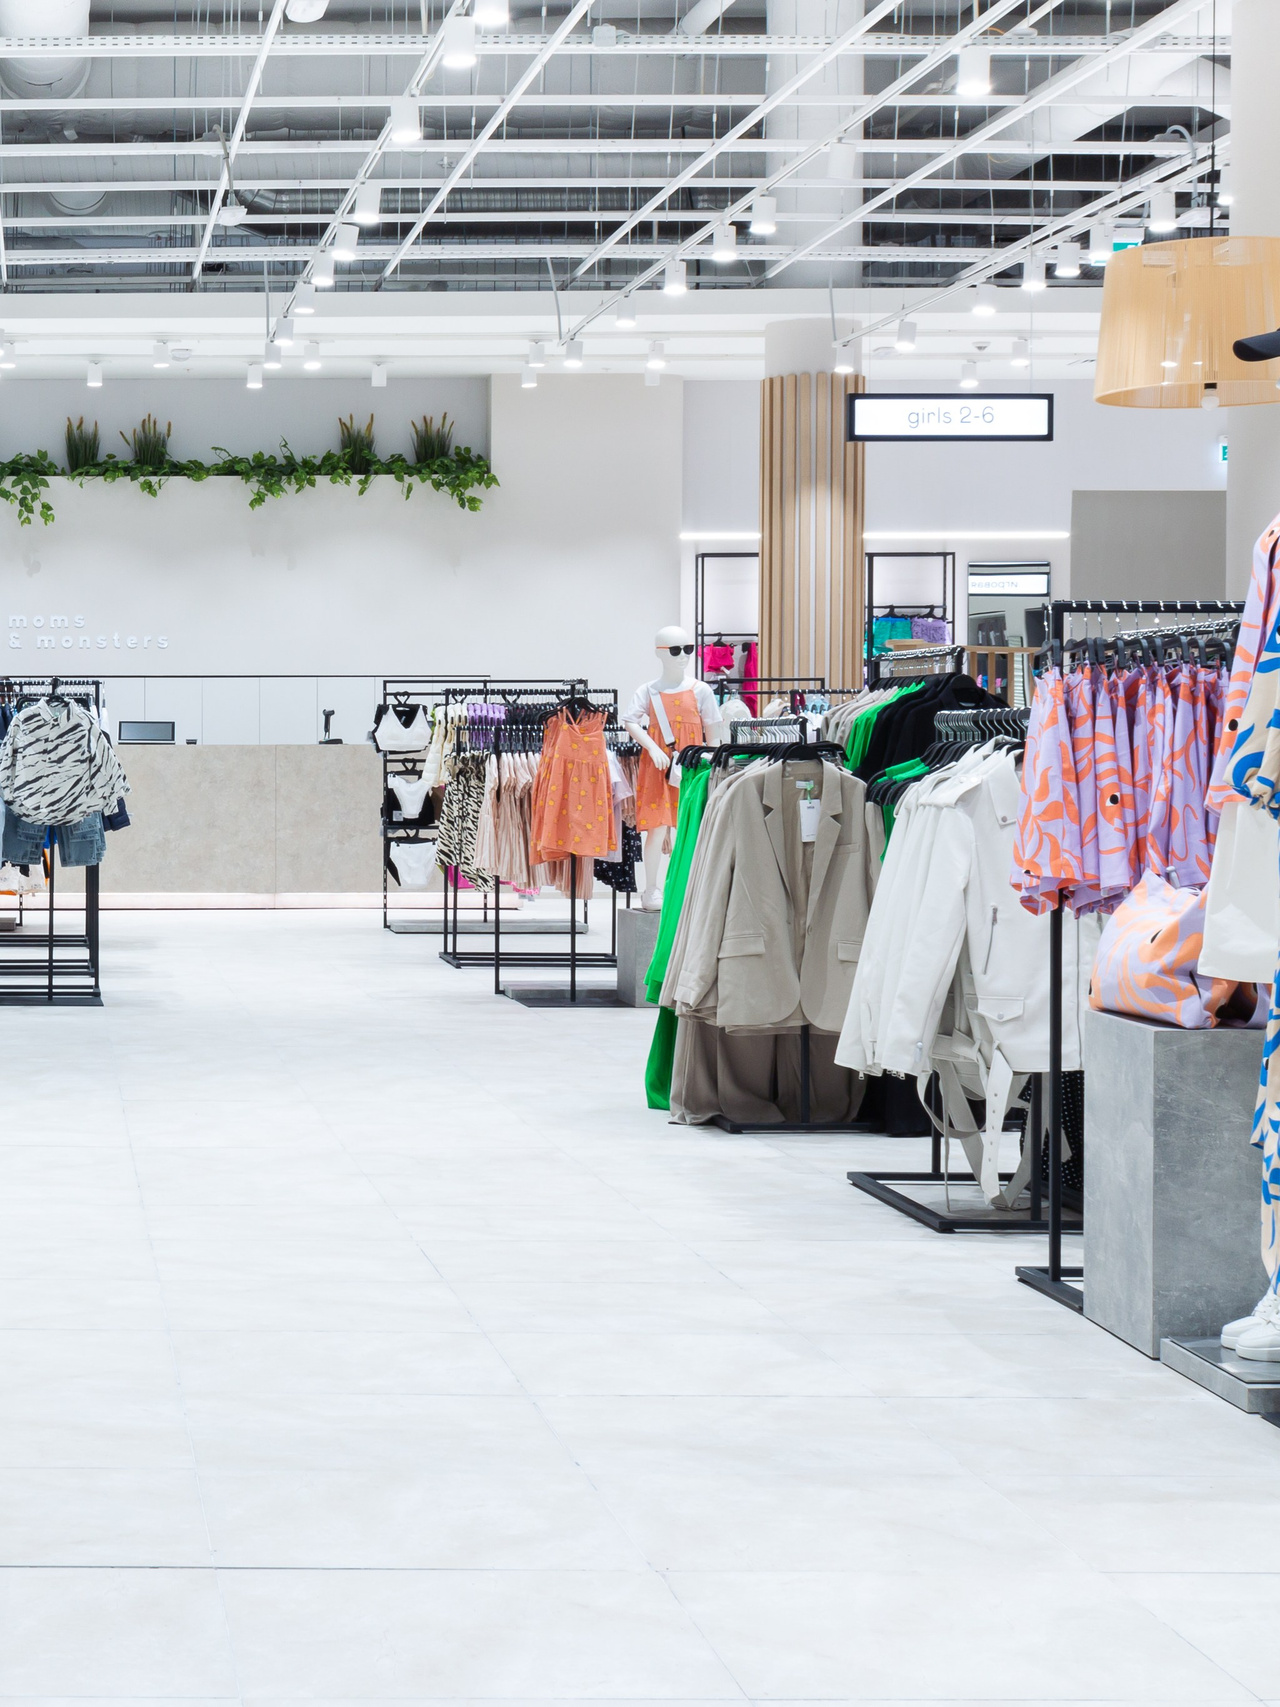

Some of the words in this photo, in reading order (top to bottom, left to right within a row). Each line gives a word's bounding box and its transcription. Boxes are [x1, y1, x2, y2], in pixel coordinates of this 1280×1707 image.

[907, 407, 952, 429] girls
[959, 406, 995, 424] 2-6
[8, 614, 86, 629] moms
[8, 632, 22, 649] &
[36, 632, 169, 649] monsters
